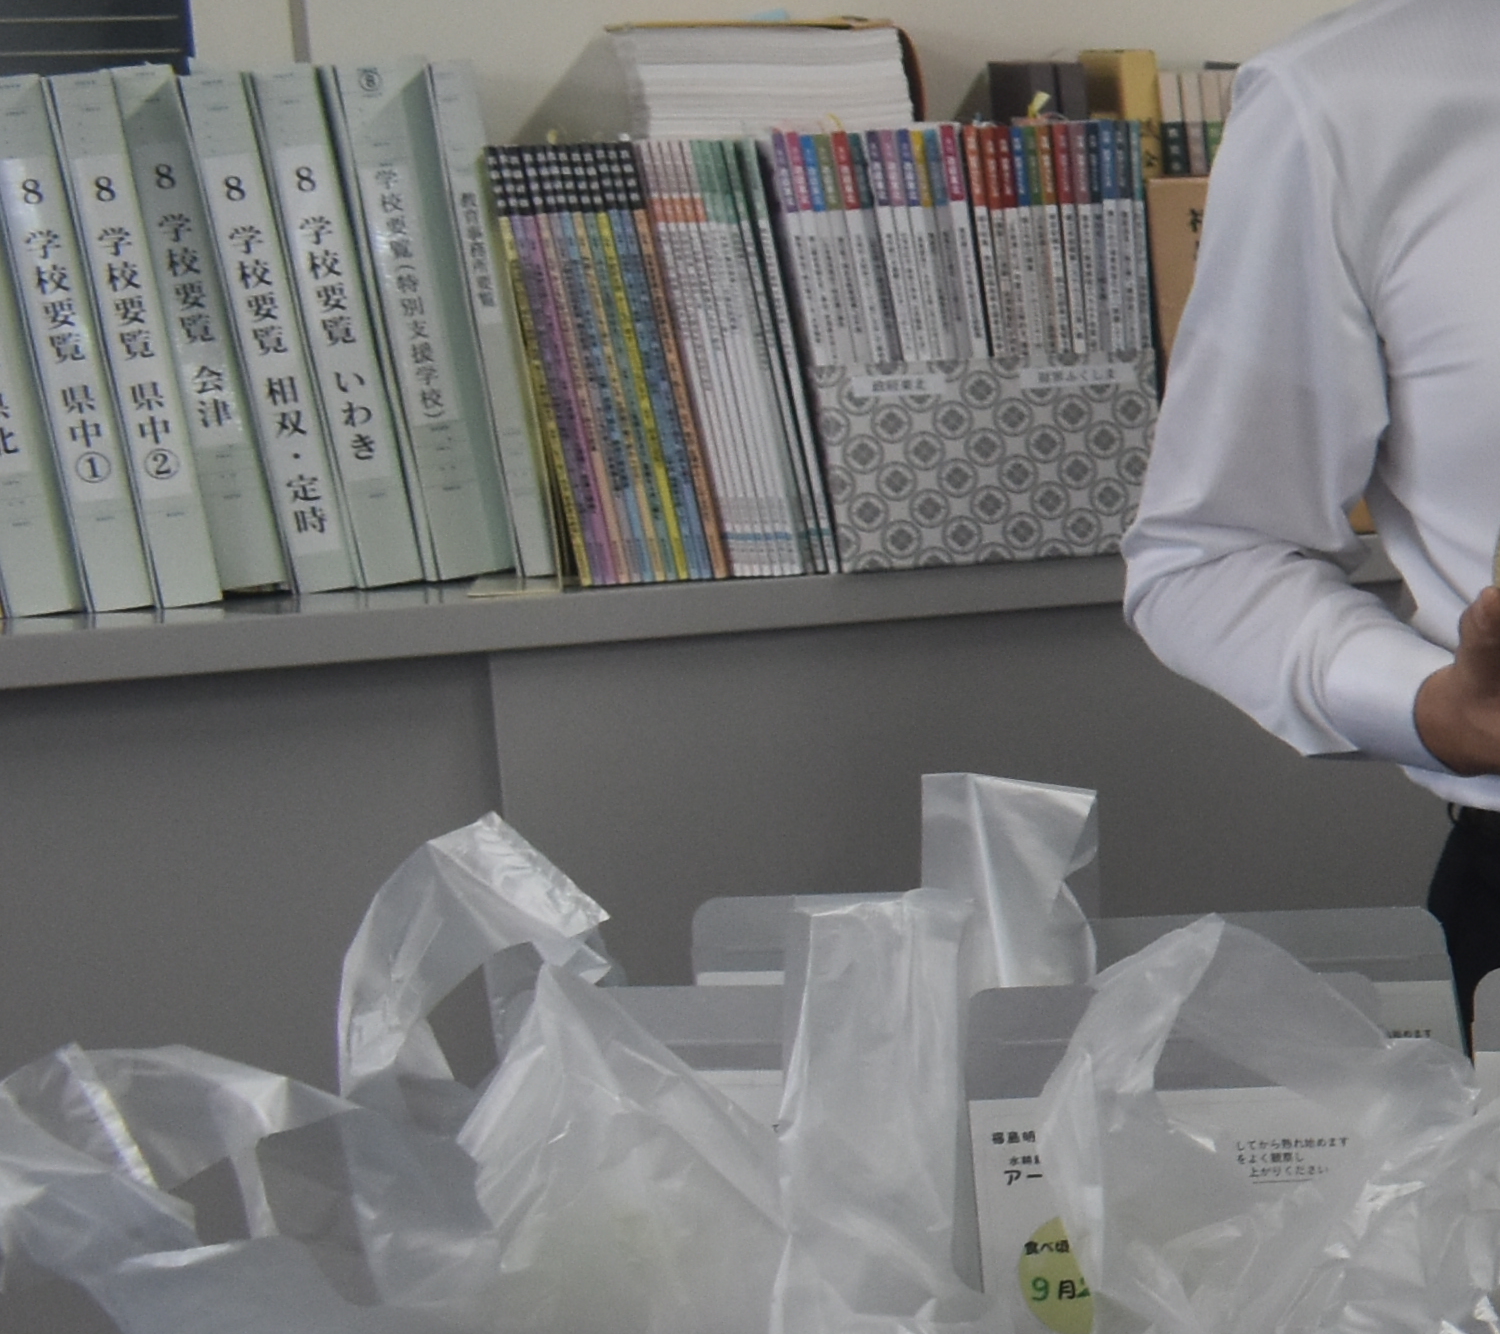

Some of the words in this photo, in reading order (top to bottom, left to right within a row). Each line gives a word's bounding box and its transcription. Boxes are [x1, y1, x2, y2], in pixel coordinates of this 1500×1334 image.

[22, 178, 43, 205] 8
[95, 174, 117, 203] 8
[154, 163, 177, 190] 8
[225, 175, 247, 202] 8
[295, 165, 317, 193] 8
[24, 229, 86, 364] 学校要覧
[96, 225, 156, 361] 学校要覧
[157, 213, 217, 345] 学校要覧
[227, 224, 289, 357] 学校要覧
[298, 215, 357, 346] 学校要覧
[191, 364, 235, 431] 会津
[335, 371, 380, 462] いわき
[266, 376, 328, 535] 相双・定時
[1023, 1239, 1071, 1256] 食べ頃
